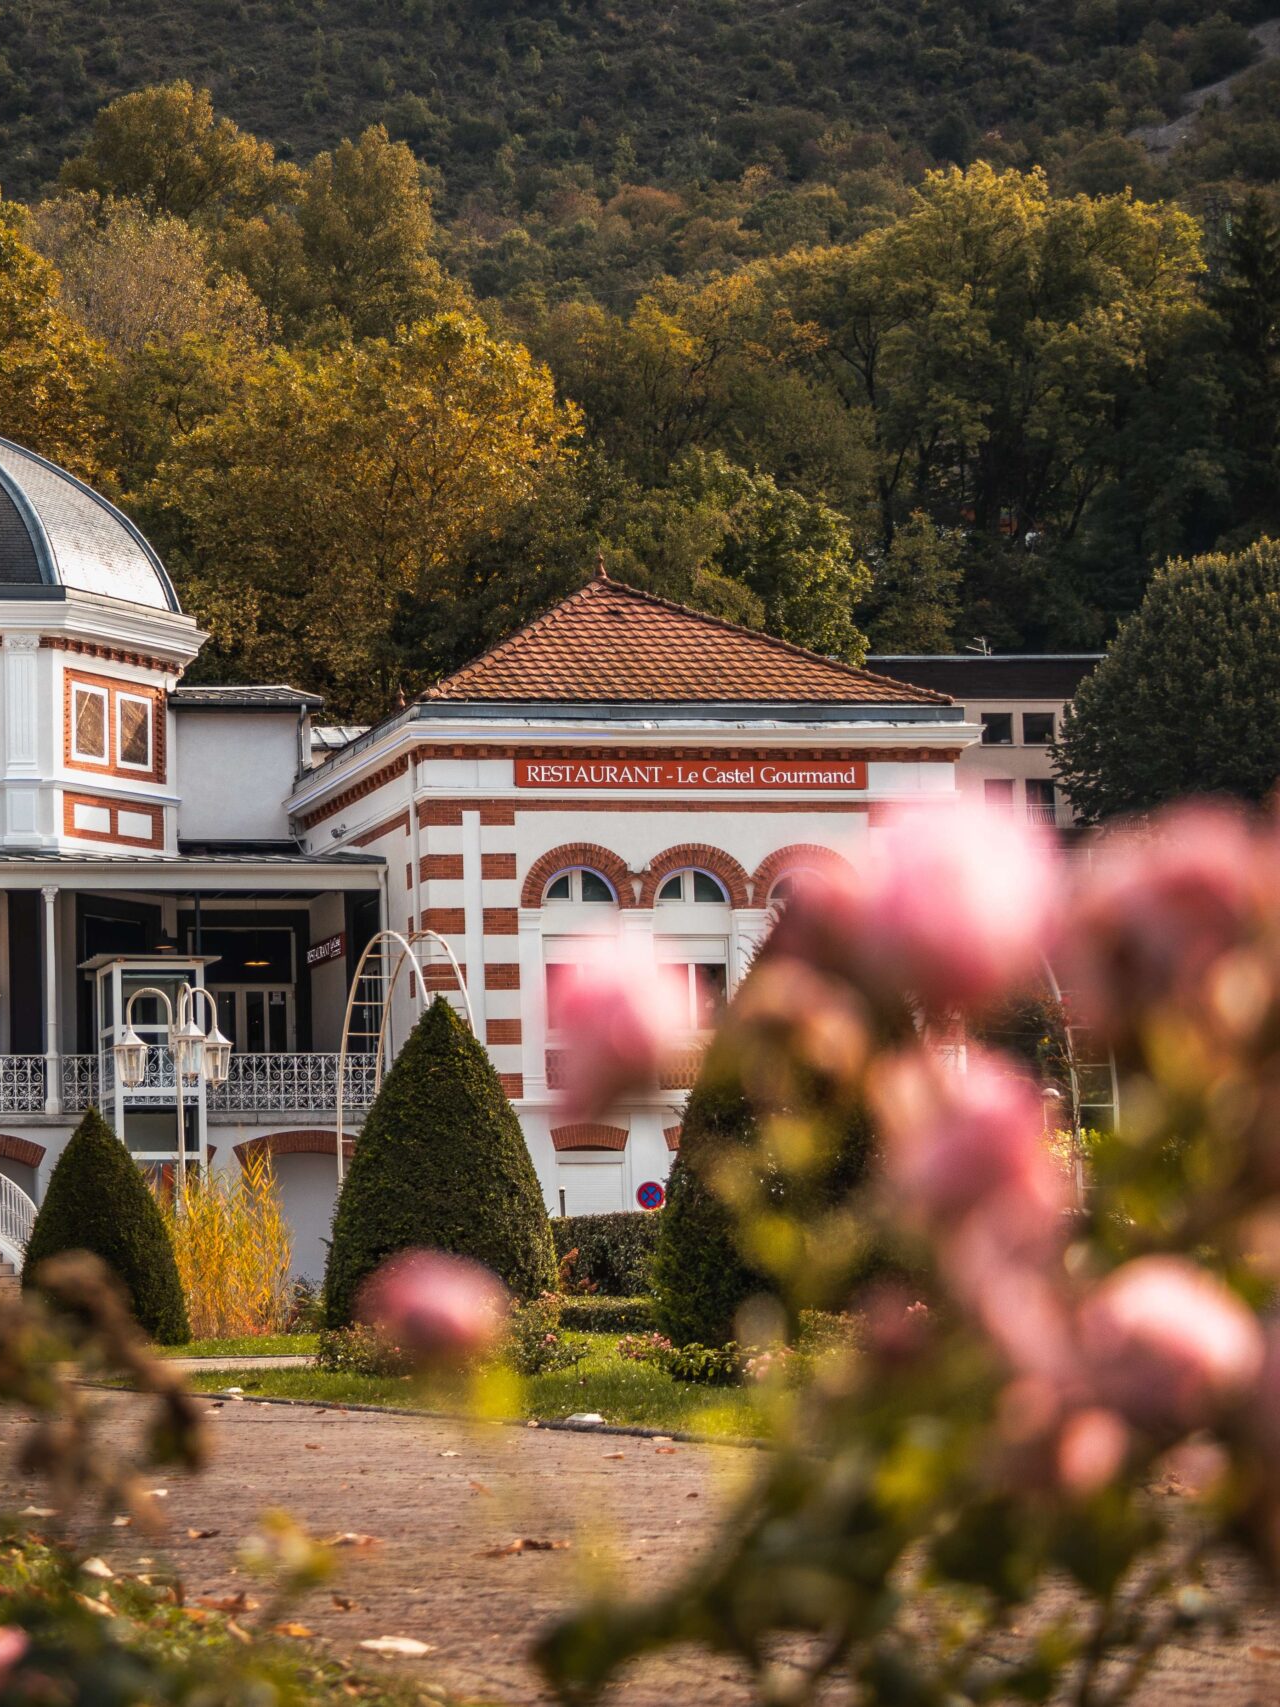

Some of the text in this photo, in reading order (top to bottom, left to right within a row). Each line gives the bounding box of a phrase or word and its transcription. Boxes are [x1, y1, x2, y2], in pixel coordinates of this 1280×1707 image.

[526, 766, 663, 783] RESTAURANT
[677, 766, 698, 783] Le
[702, 766, 754, 784] Castel
[760, 766, 856, 784] Gourmand
